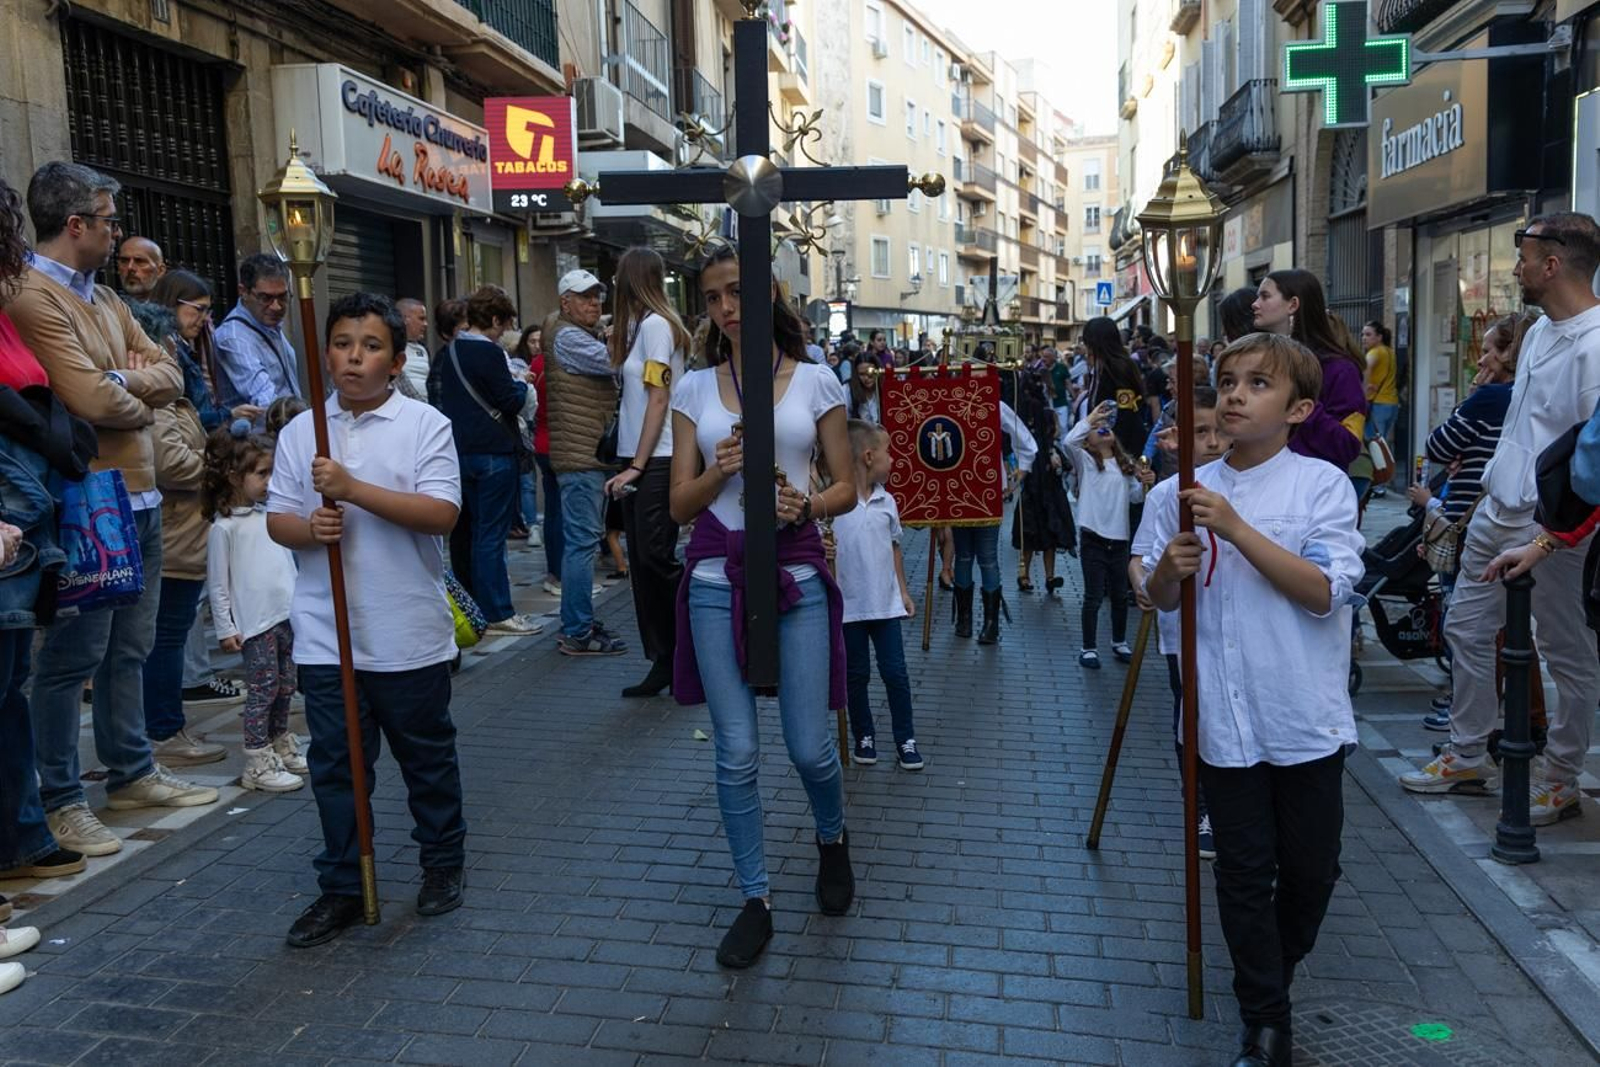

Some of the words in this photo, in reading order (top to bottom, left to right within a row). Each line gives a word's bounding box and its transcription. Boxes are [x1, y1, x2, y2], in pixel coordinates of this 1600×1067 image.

[1380, 90, 1463, 179] farmacia
[377, 133, 405, 185] La
[494, 160, 568, 174] TABACOS
[511, 194, 528, 207] 23
[1398, 629, 1432, 640] asalv
